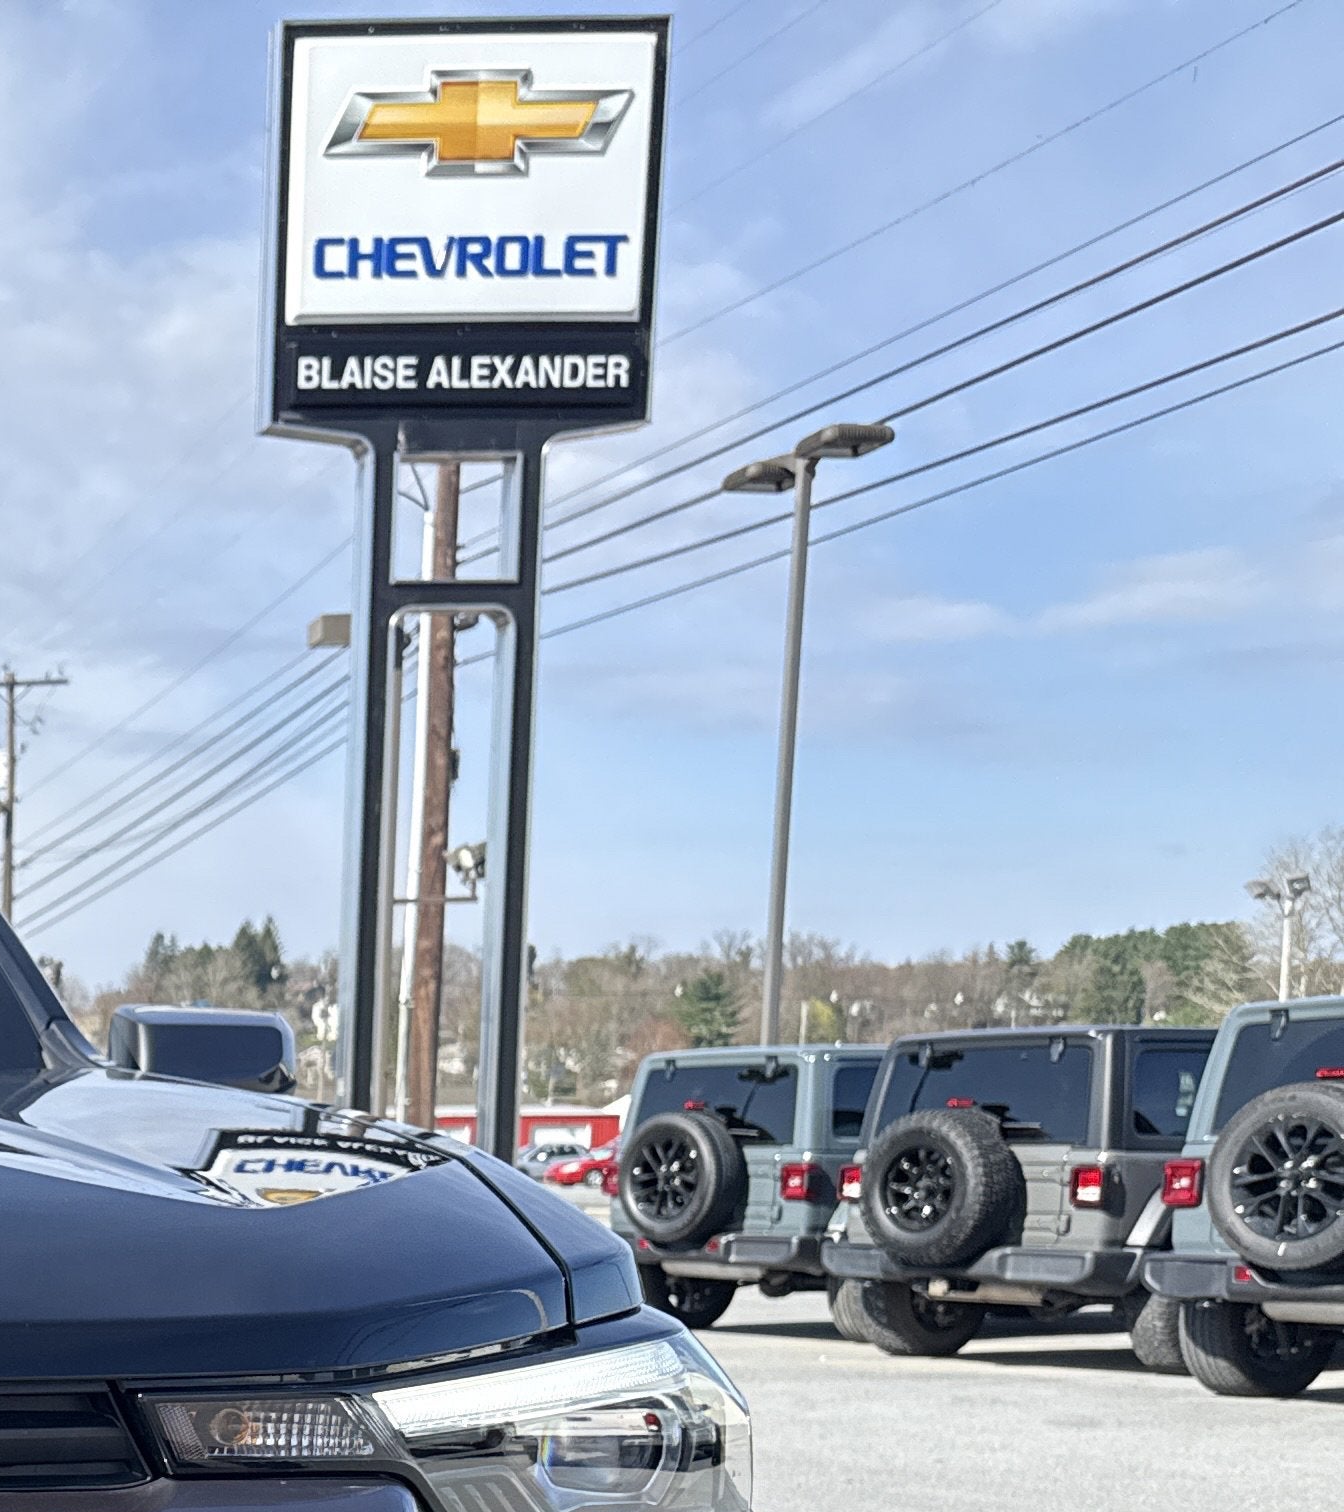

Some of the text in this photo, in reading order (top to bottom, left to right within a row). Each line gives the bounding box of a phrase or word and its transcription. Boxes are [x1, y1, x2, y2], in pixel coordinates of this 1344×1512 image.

[313, 234, 629, 279] CHEVROLET
[296, 353, 631, 390] BLAISE ALEXANDER
